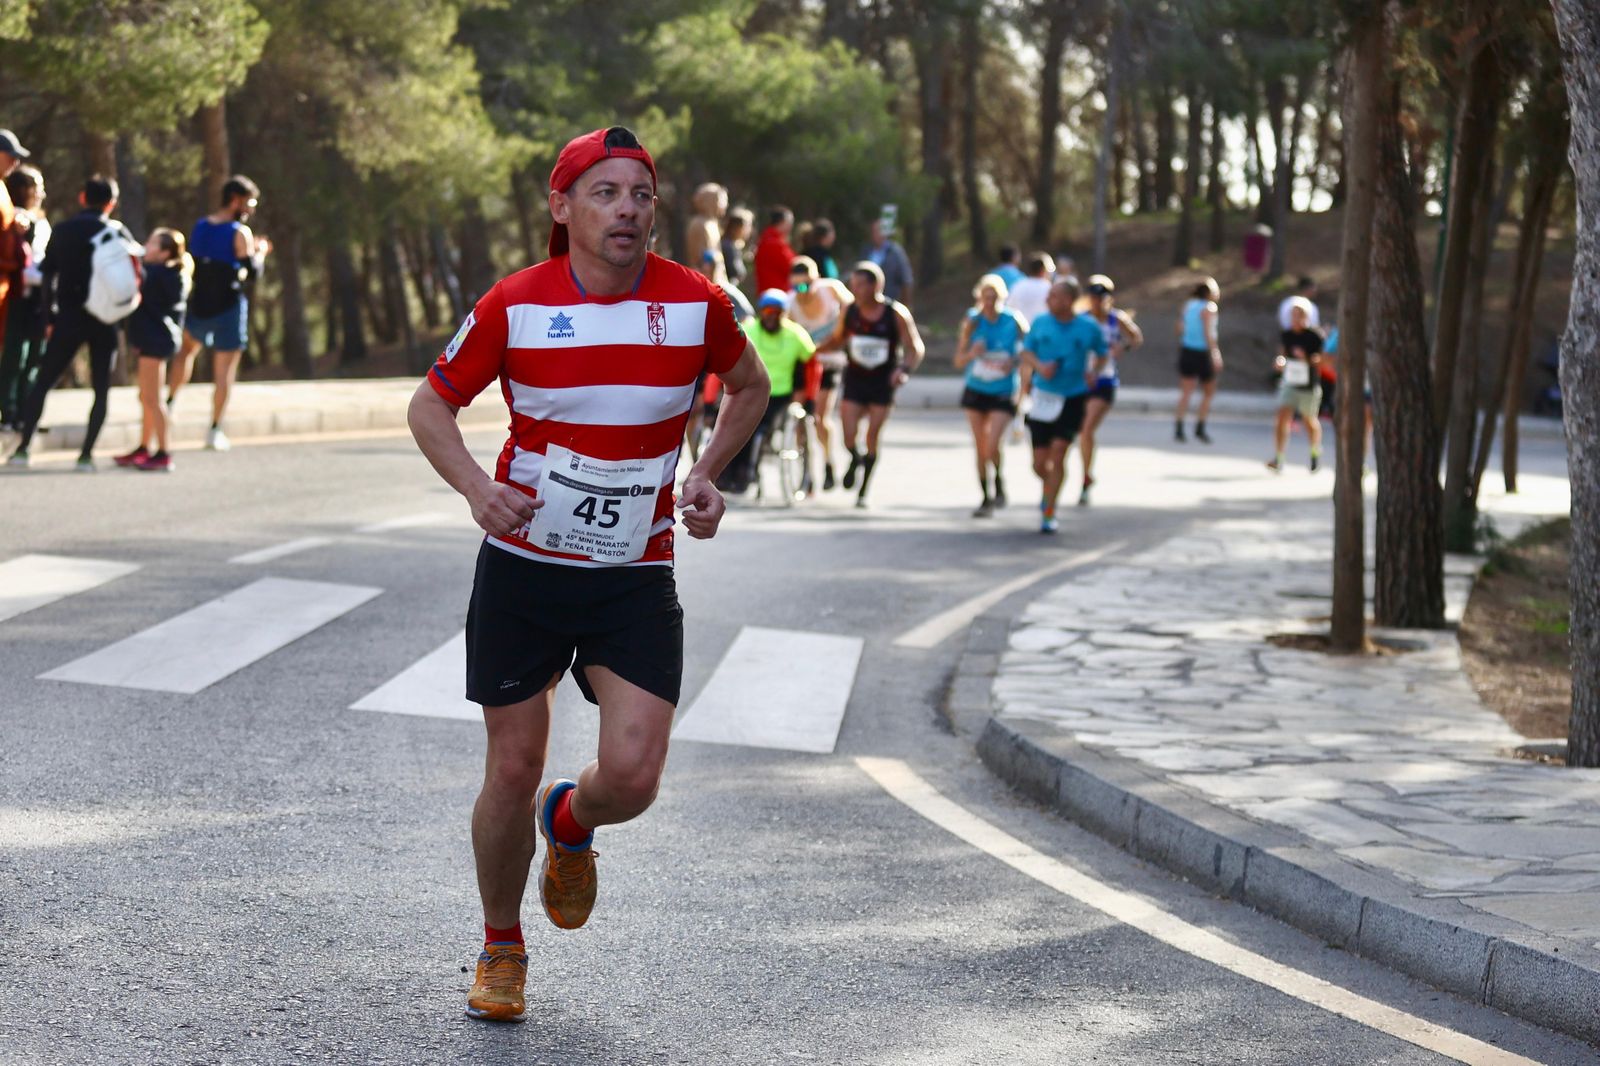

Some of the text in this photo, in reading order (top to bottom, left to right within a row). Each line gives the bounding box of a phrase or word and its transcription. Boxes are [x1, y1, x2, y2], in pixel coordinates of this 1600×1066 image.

[547, 330, 575, 339] luanvi
[582, 462, 619, 473] Ayuntamiento
[572, 496, 621, 529] 45
[578, 536, 594, 544] MINI
[595, 539, 630, 548] MARATÓN
[564, 541, 584, 551] PEÑA
[597, 548, 626, 557] BASTÓN
